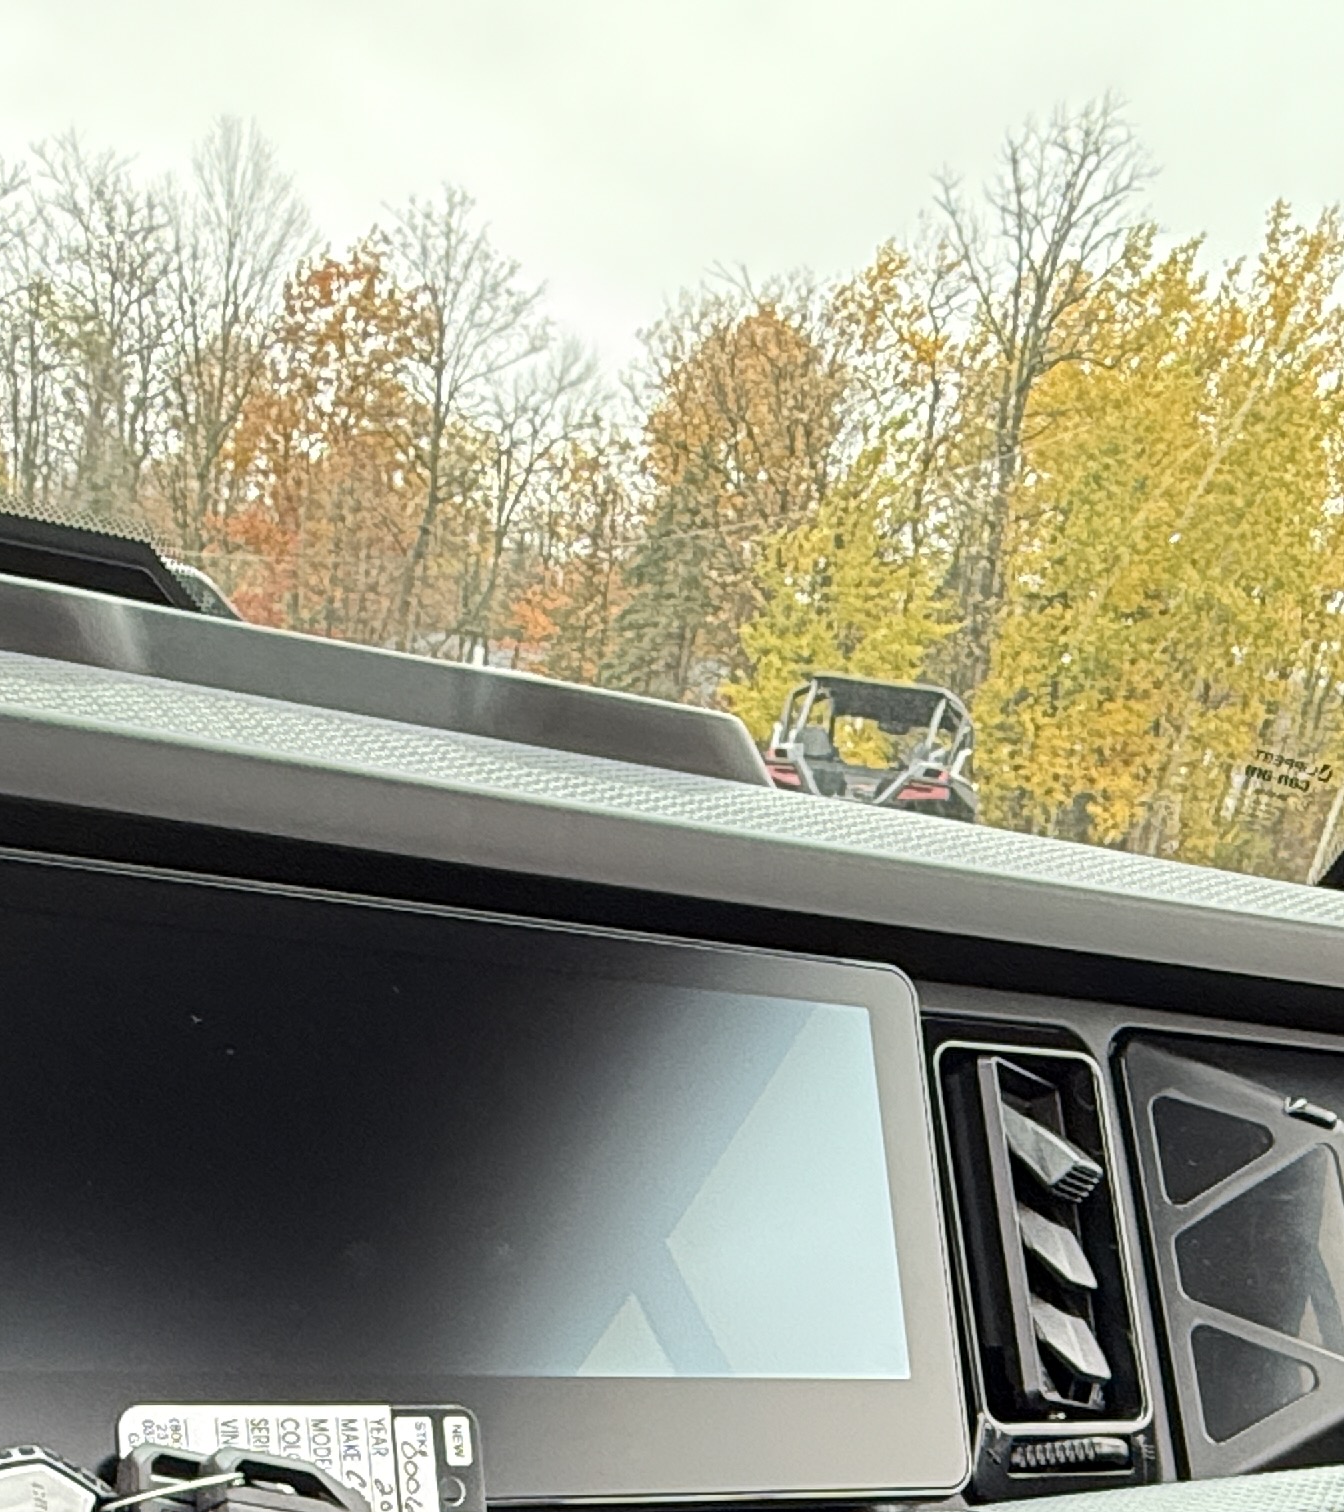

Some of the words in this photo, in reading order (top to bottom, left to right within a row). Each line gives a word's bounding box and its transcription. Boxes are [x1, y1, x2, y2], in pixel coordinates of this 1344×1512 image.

[341, 1418, 362, 1462] MAKE
[369, 1417, 390, 1457] YEAR
[452, 1424, 465, 1458] NEW
